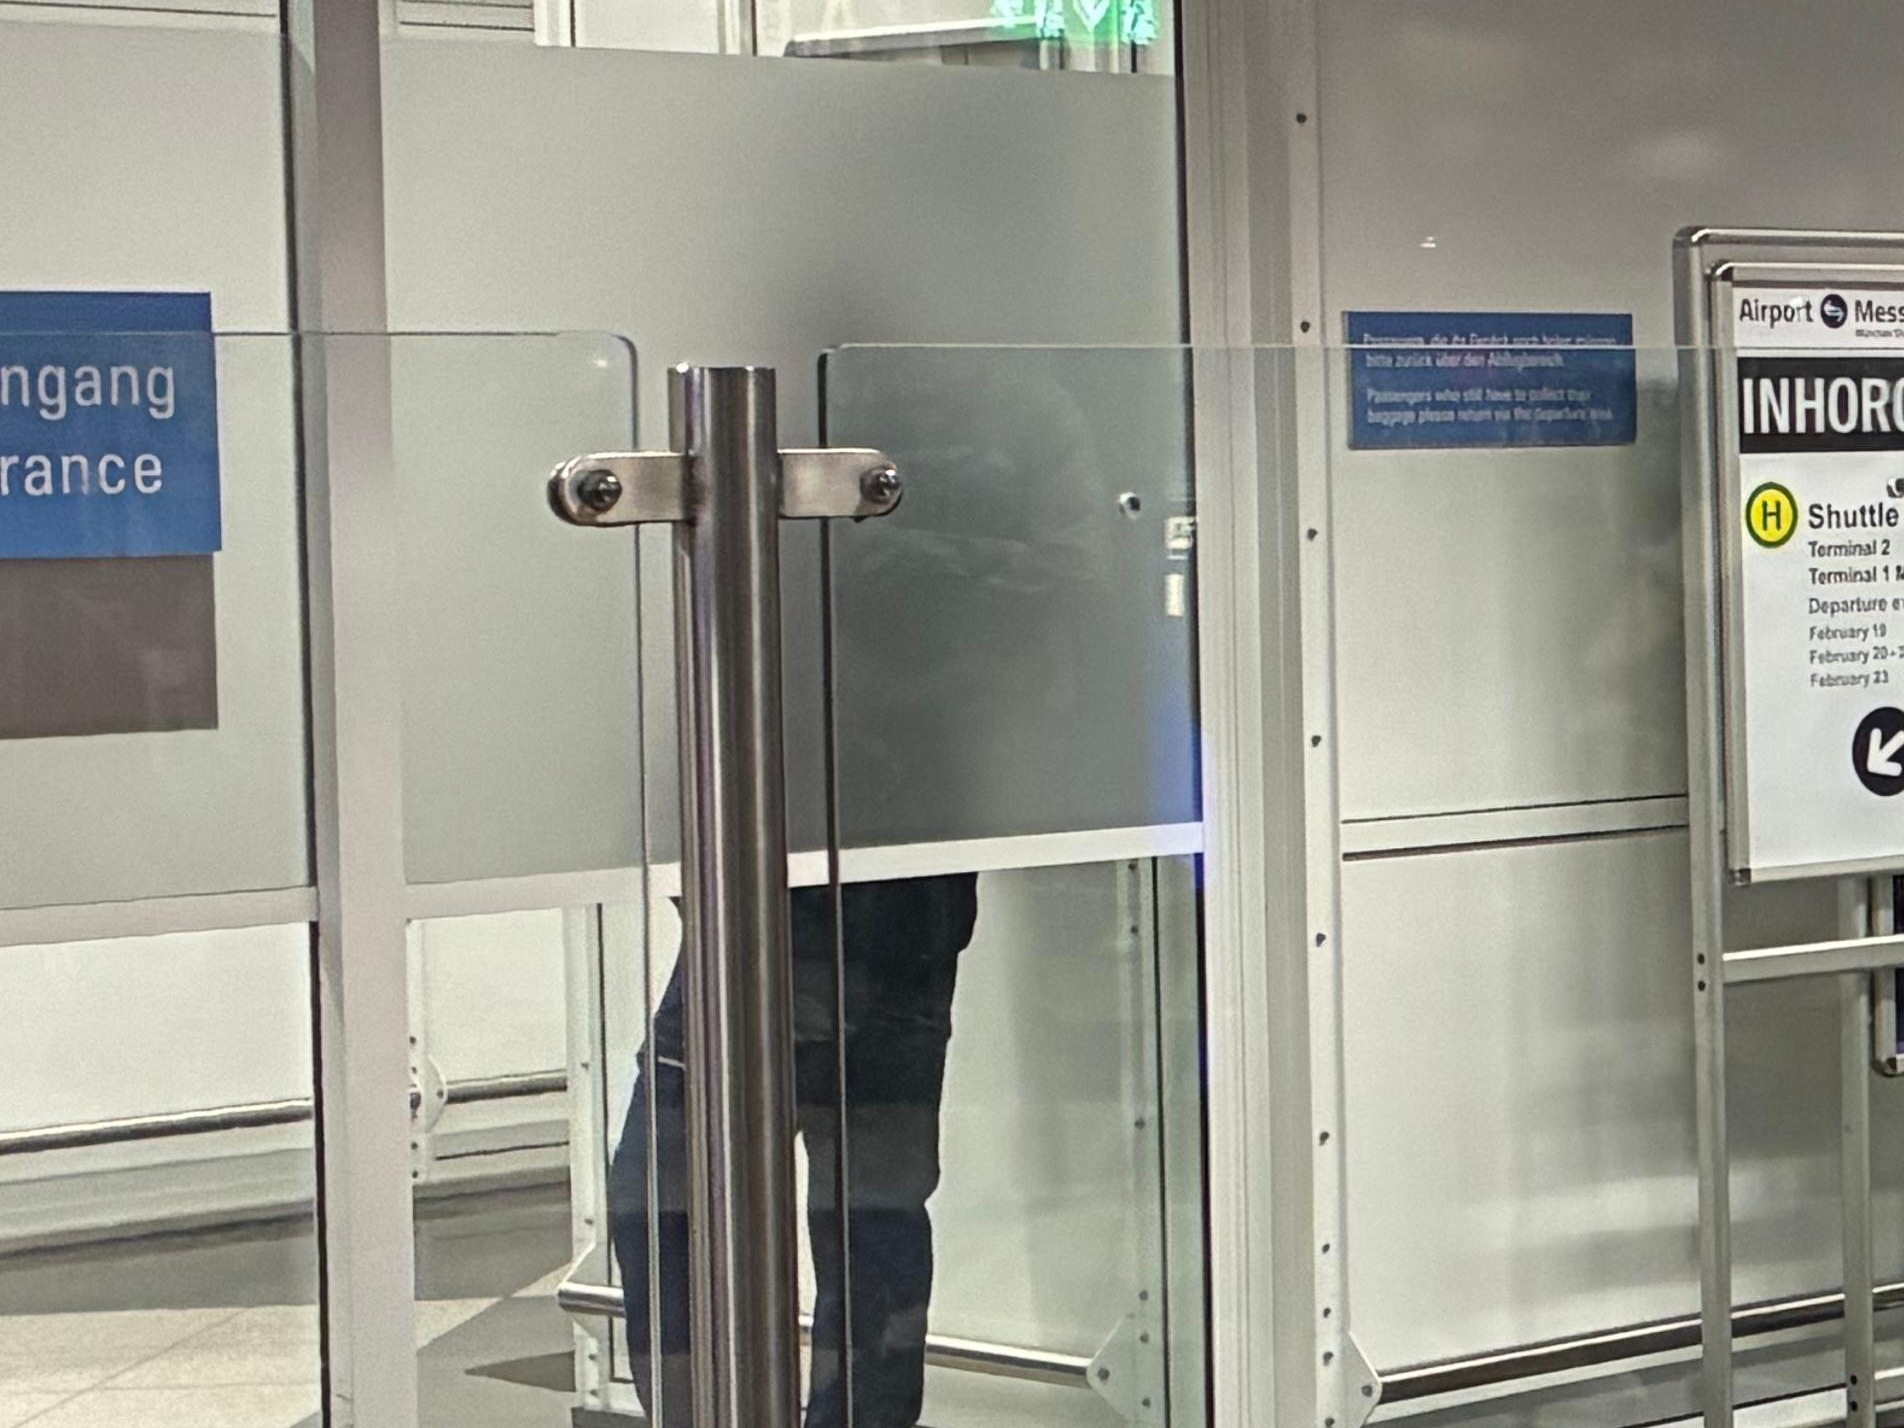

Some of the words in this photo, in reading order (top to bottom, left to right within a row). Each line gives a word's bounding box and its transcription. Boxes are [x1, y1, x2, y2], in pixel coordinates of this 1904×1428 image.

[1739, 297, 1815, 330] Airport
[1761, 499, 1783, 532] H
[1807, 500, 1900, 530] Shuttle
[1808, 539, 1877, 558] Terminal
[1881, 538, 1891, 556] 2
[1808, 565, 1877, 585] Terminal
[1882, 565, 1890, 583] 1
[1808, 595, 1888, 618] Departure
[1808, 624, 1869, 642] February
[1808, 647, 1870, 665] February
[1809, 671, 1870, 689] February
